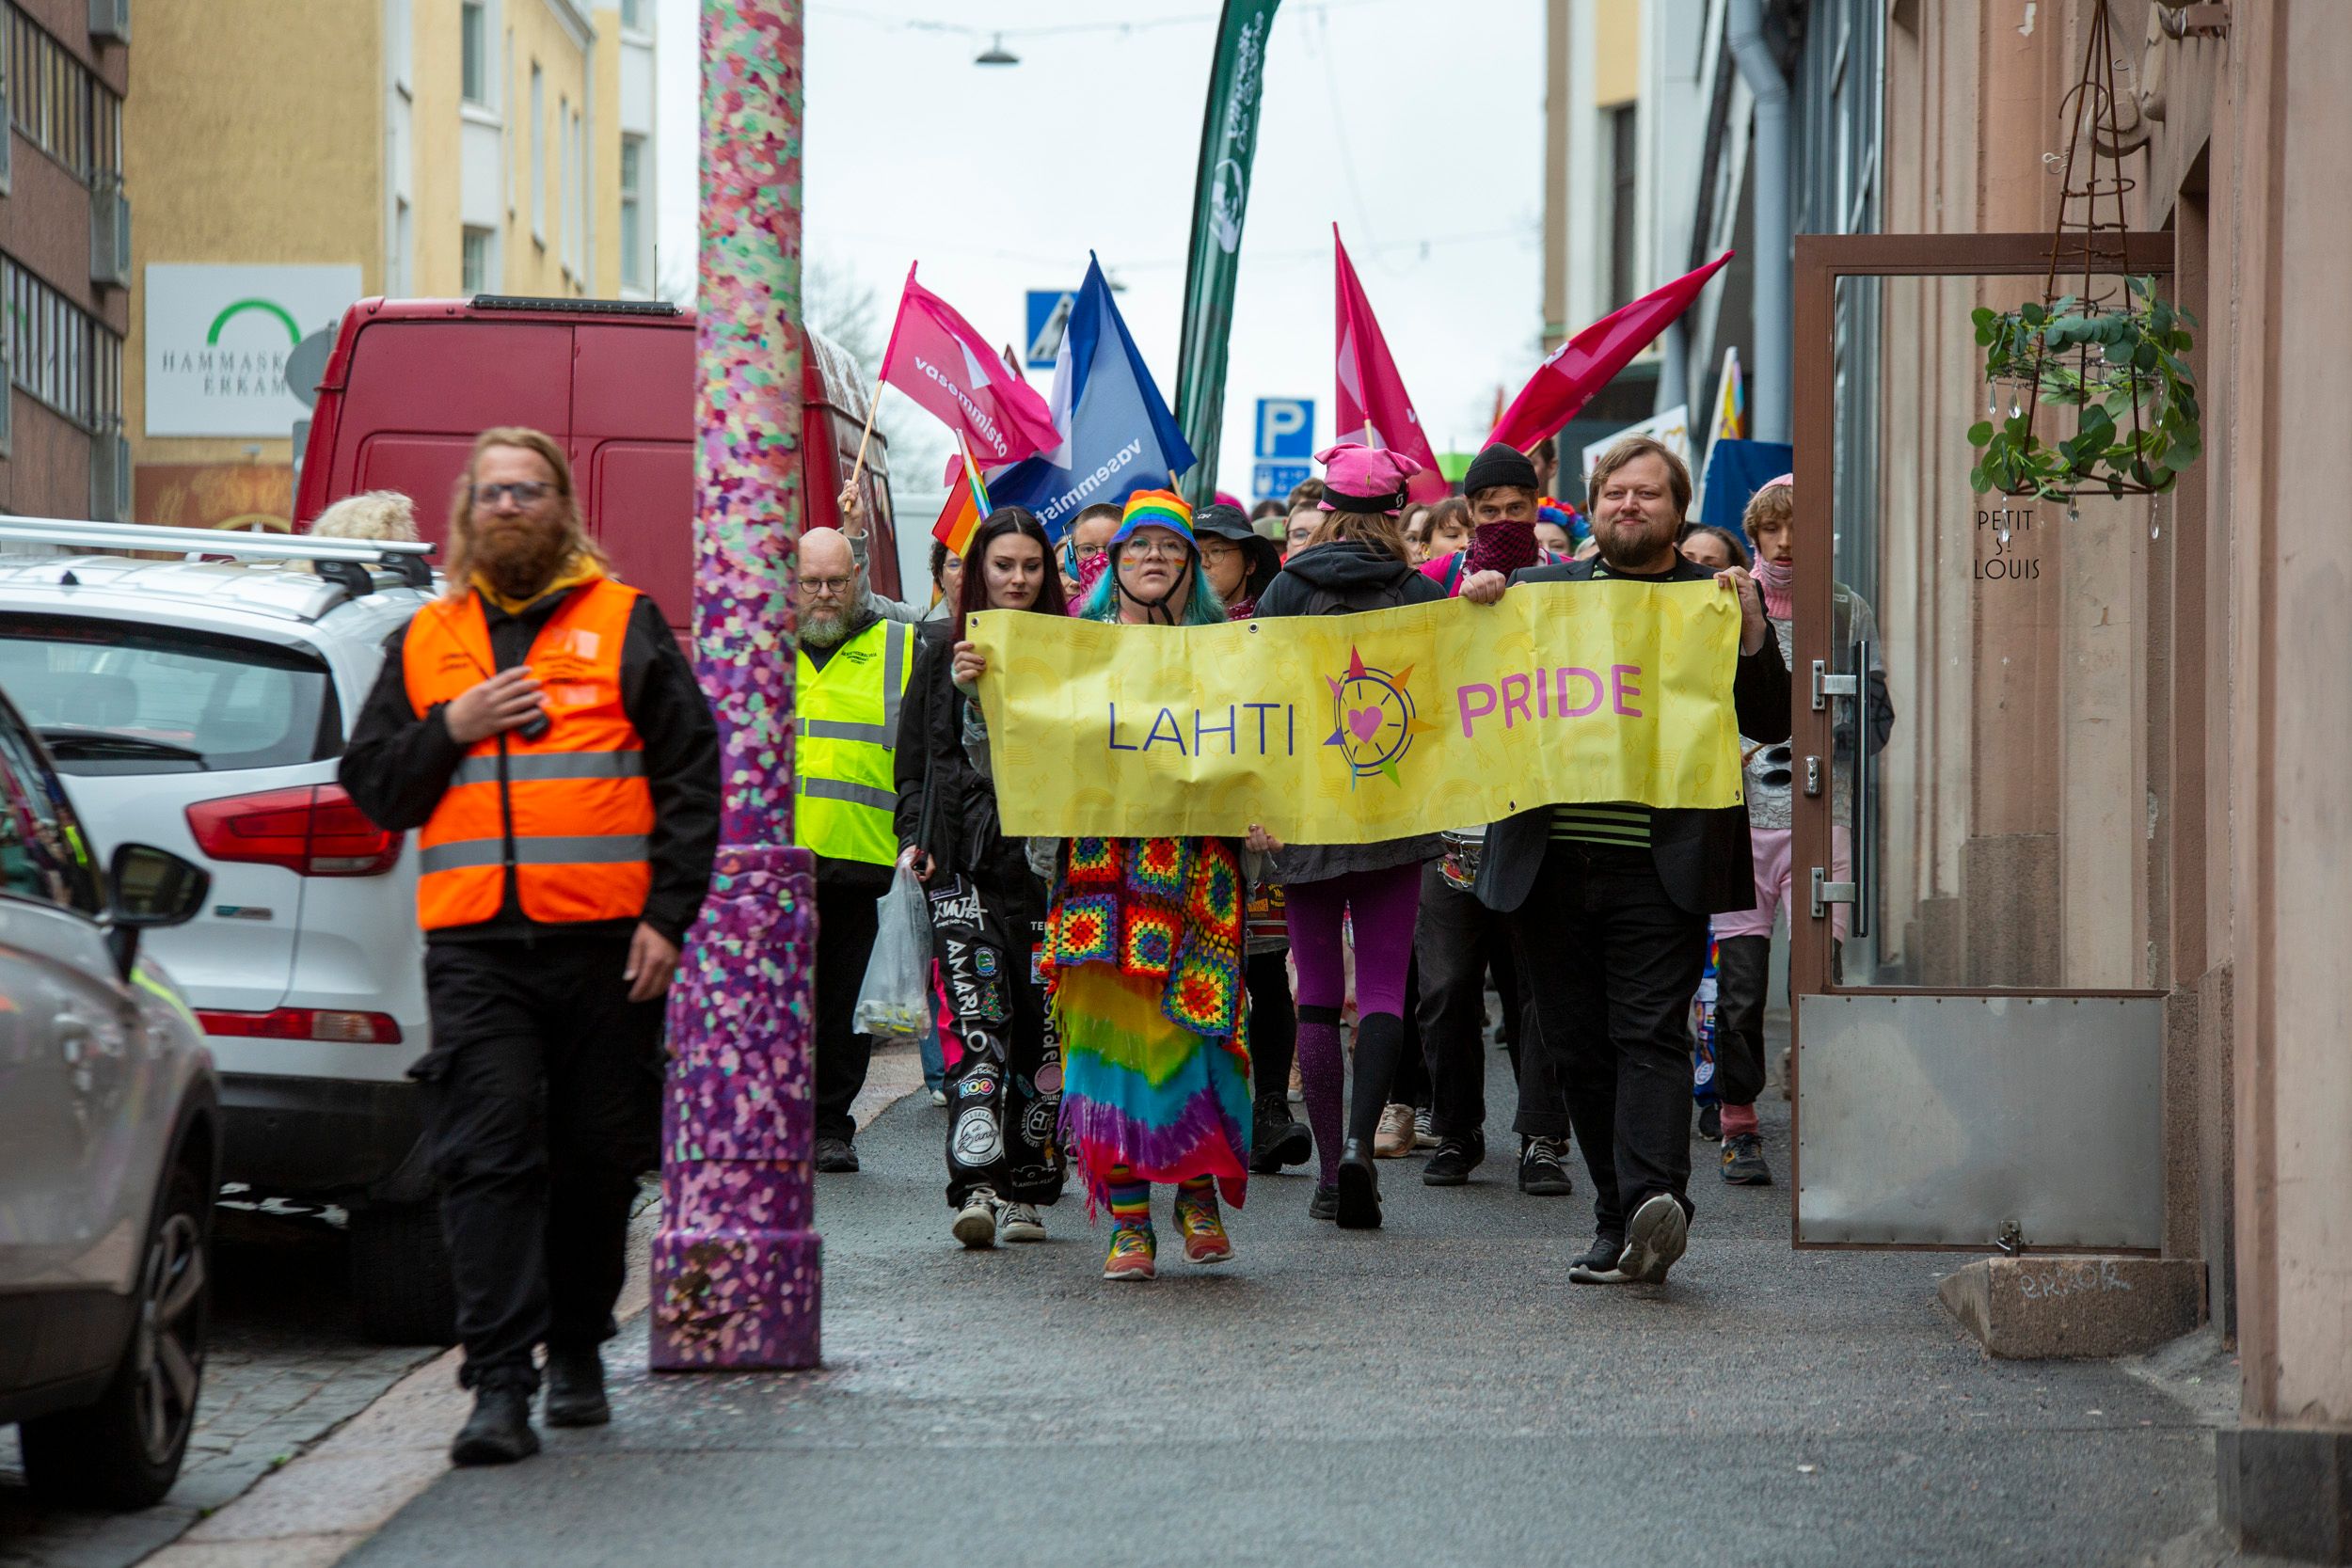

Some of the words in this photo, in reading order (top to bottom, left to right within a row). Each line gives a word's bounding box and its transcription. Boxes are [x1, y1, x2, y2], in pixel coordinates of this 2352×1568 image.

[162, 351, 283, 372] HAMMASK
[914, 356, 1008, 458] vasemmisto
[1263, 401, 1307, 456] P
[1978, 510, 2034, 531] PETIT
[1974, 559, 2040, 580] LOUIS
[1108, 702, 1295, 757] LAHTI
[1456, 663, 1644, 739] PRIDE
